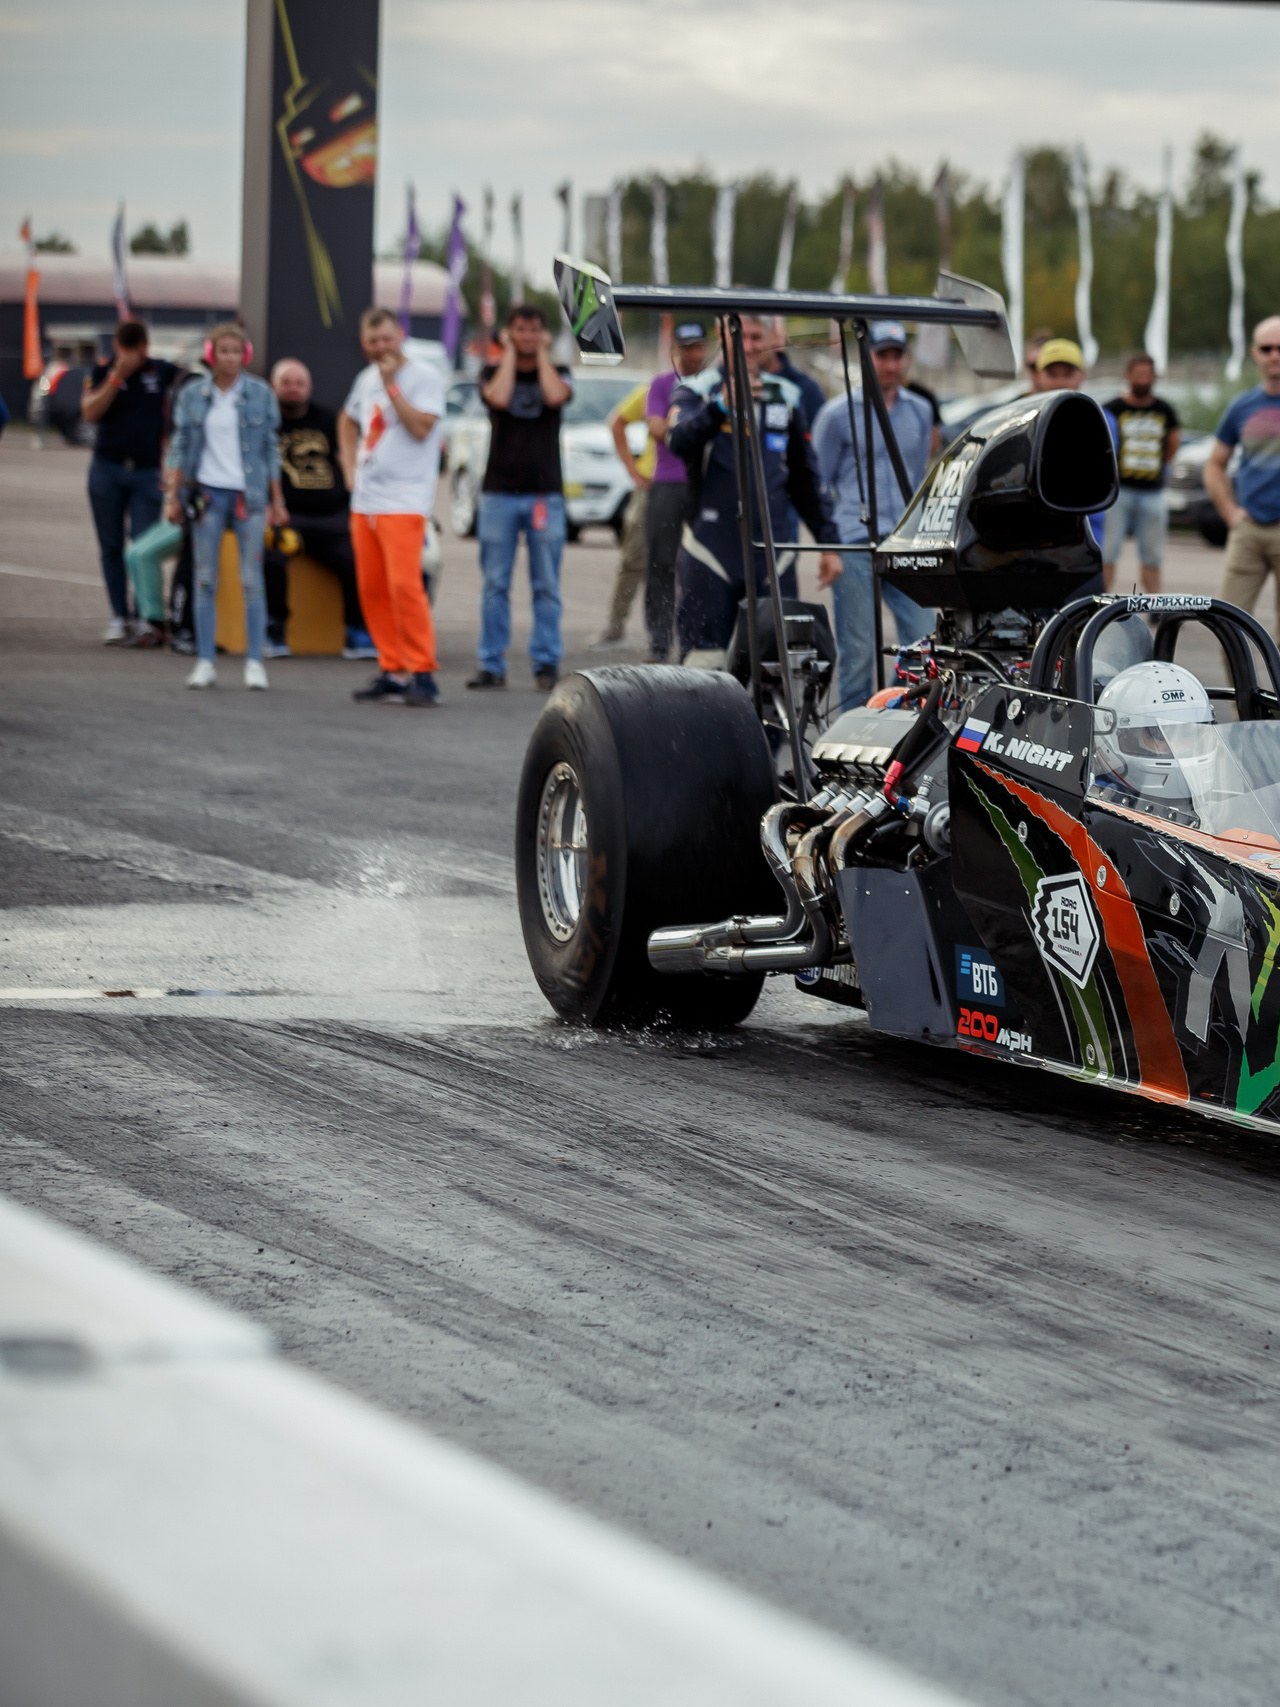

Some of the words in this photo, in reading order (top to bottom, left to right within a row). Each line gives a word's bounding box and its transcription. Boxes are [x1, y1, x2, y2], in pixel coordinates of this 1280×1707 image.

[1162, 691, 1185, 700] OMP
[983, 731, 1003, 754] K.
[1006, 738, 1073, 772] NIGHT
[1052, 907, 1080, 945] 154
[972, 962, 998, 997] ВТБ
